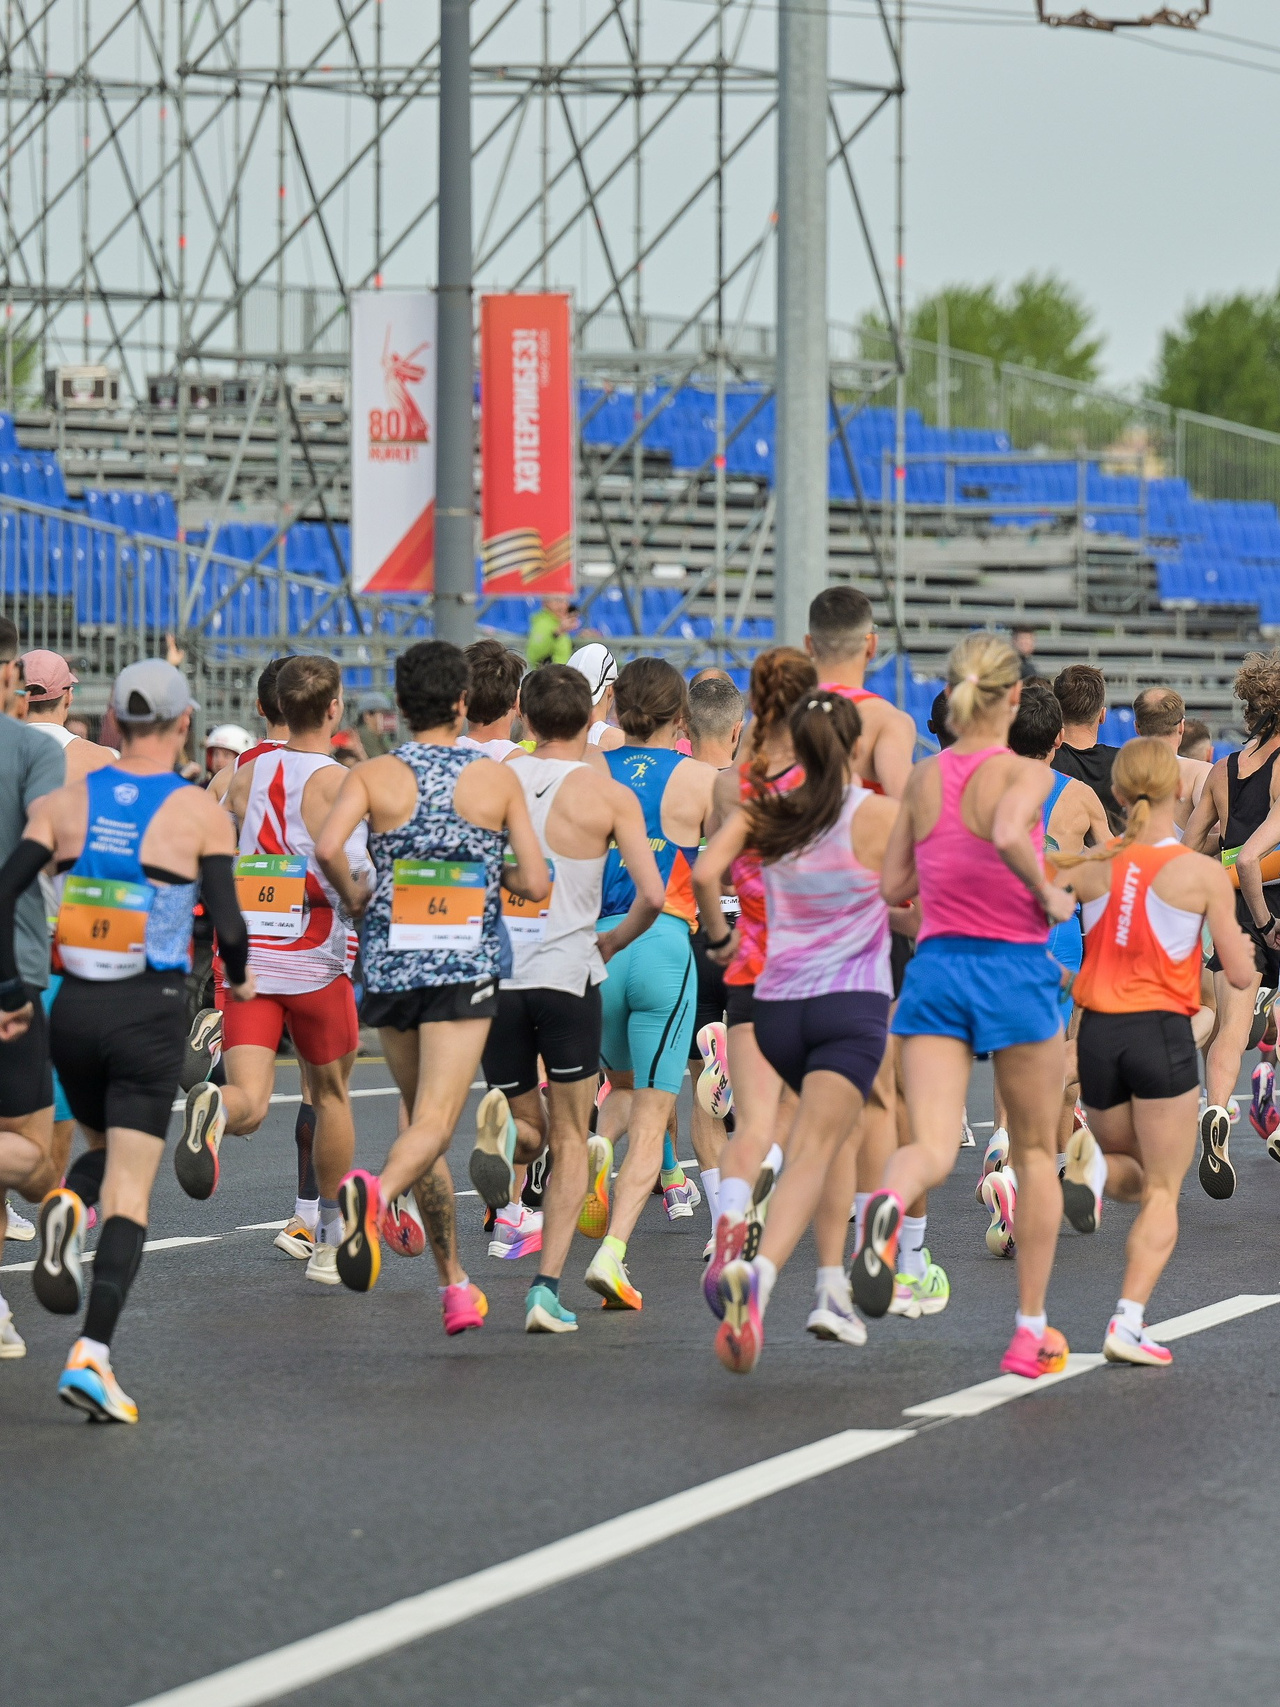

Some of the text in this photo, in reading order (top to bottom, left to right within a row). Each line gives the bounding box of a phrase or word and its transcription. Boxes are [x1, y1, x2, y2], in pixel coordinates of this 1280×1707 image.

[258, 886, 275, 903] 68
[1115, 861, 1141, 947] INSANITY
[428, 897, 447, 915] 64
[91, 918, 111, 940] 69
